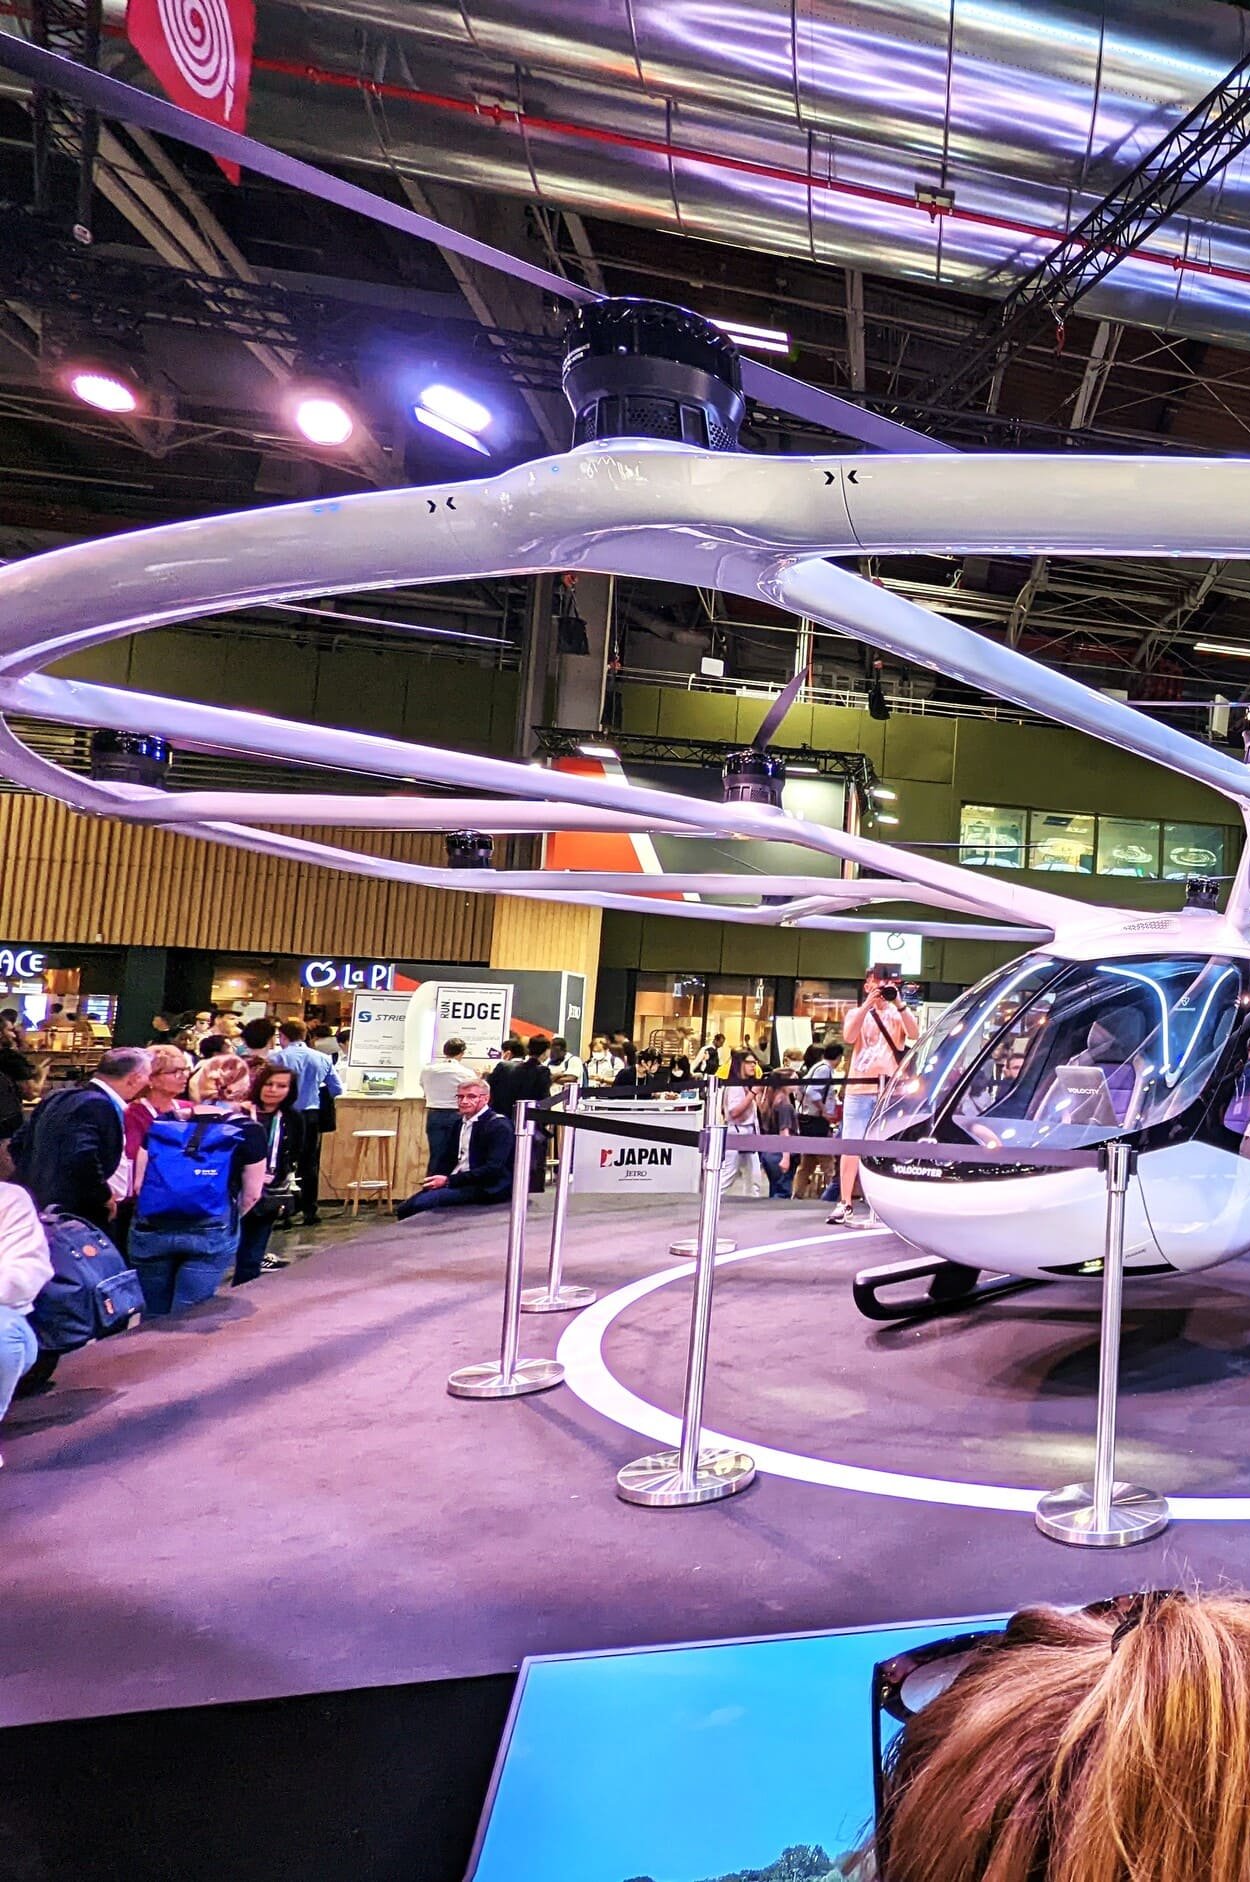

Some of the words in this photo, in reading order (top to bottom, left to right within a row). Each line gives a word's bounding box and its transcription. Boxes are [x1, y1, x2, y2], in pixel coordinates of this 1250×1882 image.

[451, 1001, 502, 1021] EDGE
[613, 1148, 672, 1167] JAPAN
[625, 1169, 647, 1178] JETRO
[892, 1163, 942, 1178] VOLOCOPTER
